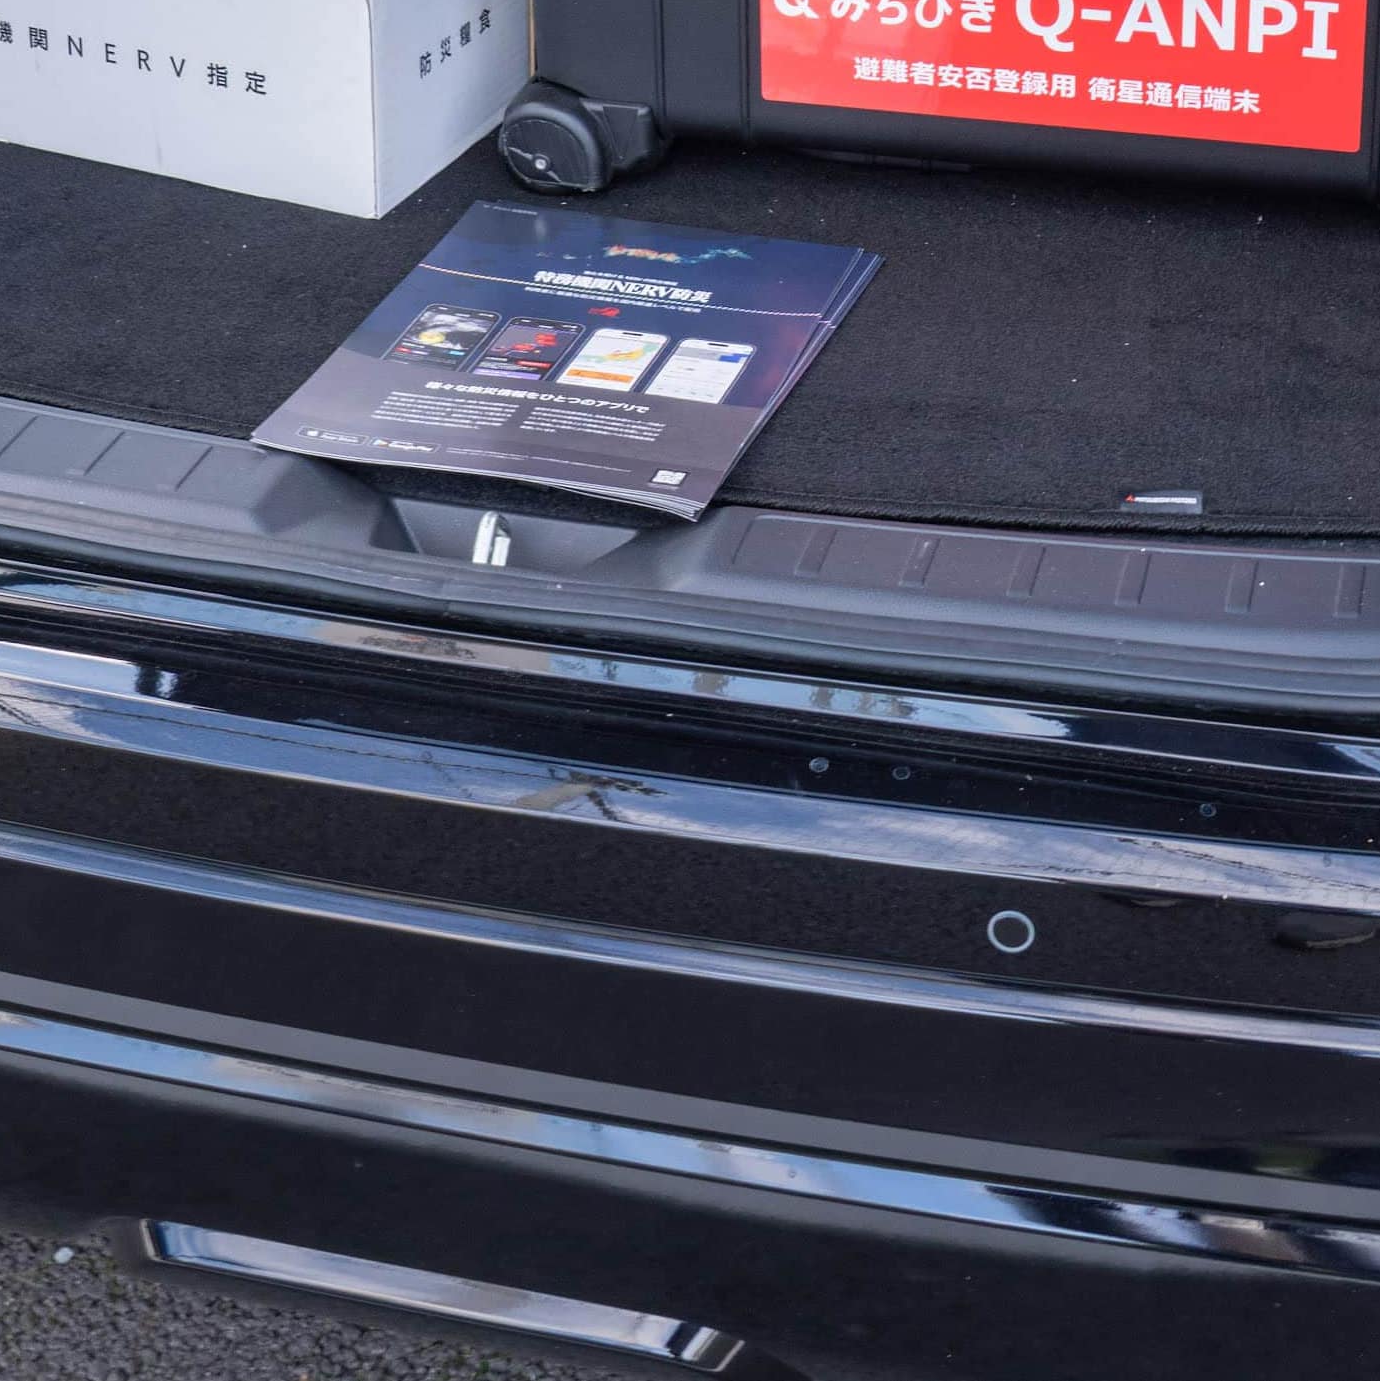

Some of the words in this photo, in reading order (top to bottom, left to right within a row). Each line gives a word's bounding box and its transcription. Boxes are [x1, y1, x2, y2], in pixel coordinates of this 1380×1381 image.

[853, 56, 1077, 99] 避難者安否登録用
[1088, 77, 1261, 114] 衛星通信端末
